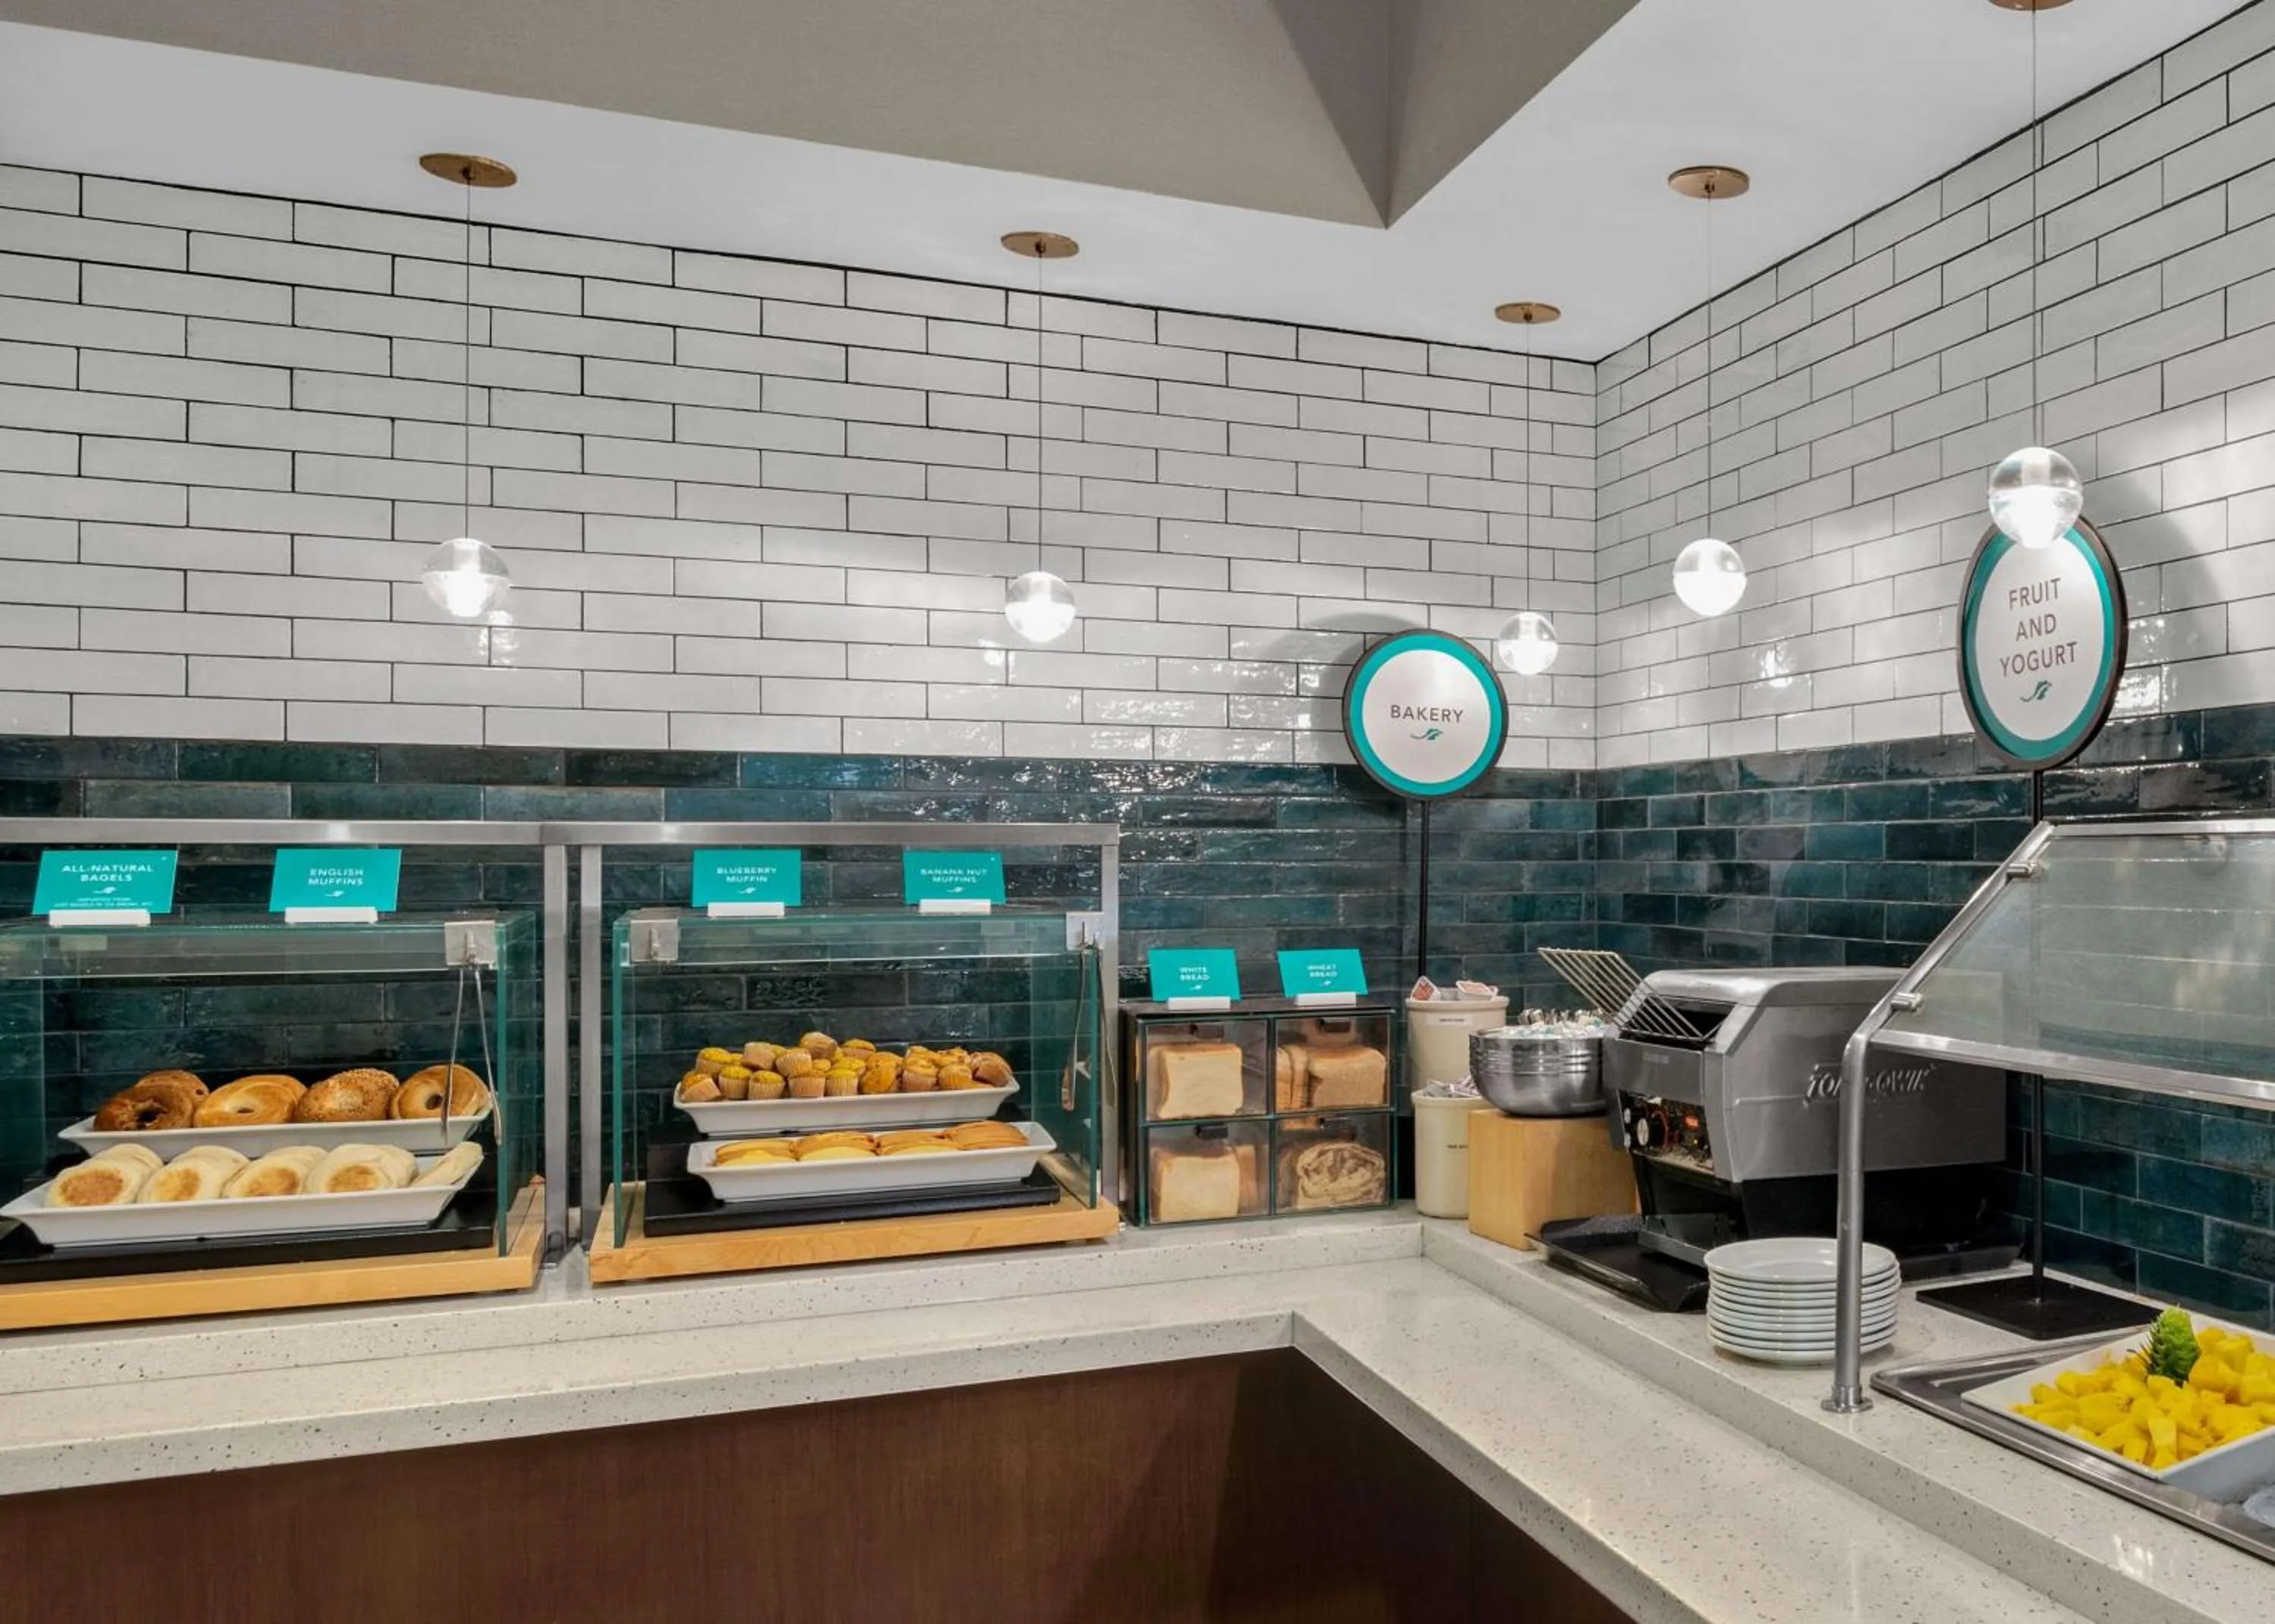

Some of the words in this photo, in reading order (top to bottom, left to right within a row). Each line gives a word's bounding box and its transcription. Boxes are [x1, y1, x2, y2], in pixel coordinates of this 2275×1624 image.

[2008, 577, 2061, 611] FRUIT
[2015, 613, 2057, 641] AND
[1999, 641, 2078, 677] YOGURT
[1389, 704, 1464, 723] BAKERY
[61, 864, 155, 873] ALL-NATURAL
[309, 868, 364, 876] ENGLISH
[80, 873, 133, 883] BAGELS
[307, 877, 364, 886] MUFFINS
[725, 875, 769, 883] MUFFIN
[931, 876, 977, 884] MUFFINS
